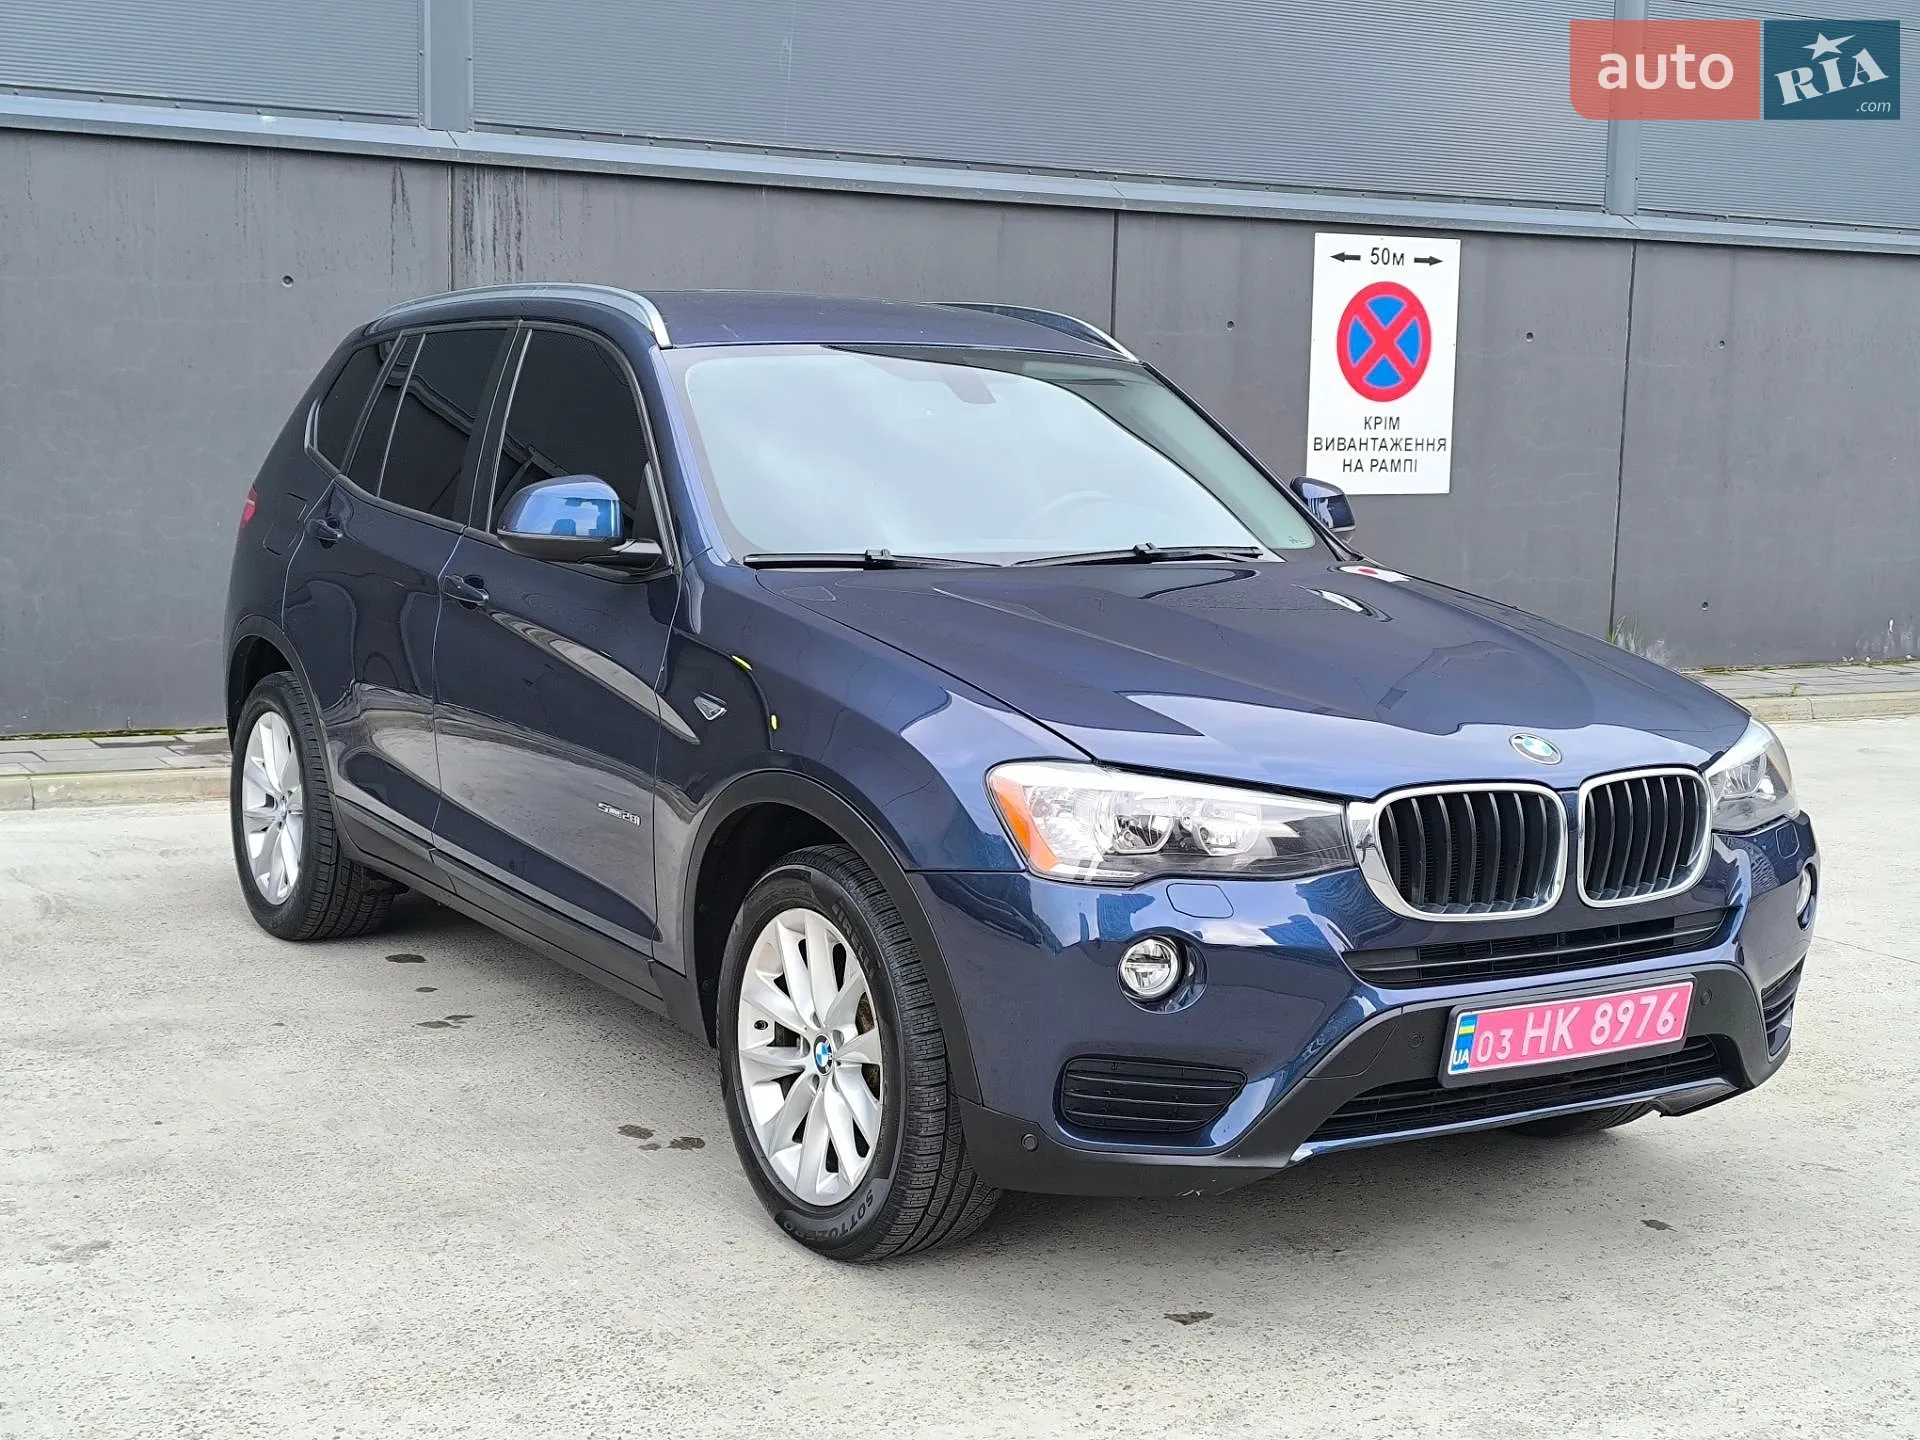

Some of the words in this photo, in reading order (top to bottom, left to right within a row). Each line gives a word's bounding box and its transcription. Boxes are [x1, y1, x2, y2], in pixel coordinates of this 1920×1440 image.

[1363, 416, 1401, 431] КРІМ
[1313, 436, 1447, 452] ВИВАНТАЖЕННЯ
[1342, 458, 1364, 473] НА
[1369, 458, 1418, 473] РАМПІ
[1476, 1027, 1515, 1064] 03
[1521, 1005, 1582, 1057] HK
[1590, 991, 1679, 1046] 8976
[1453, 1049, 1470, 1066] UA
